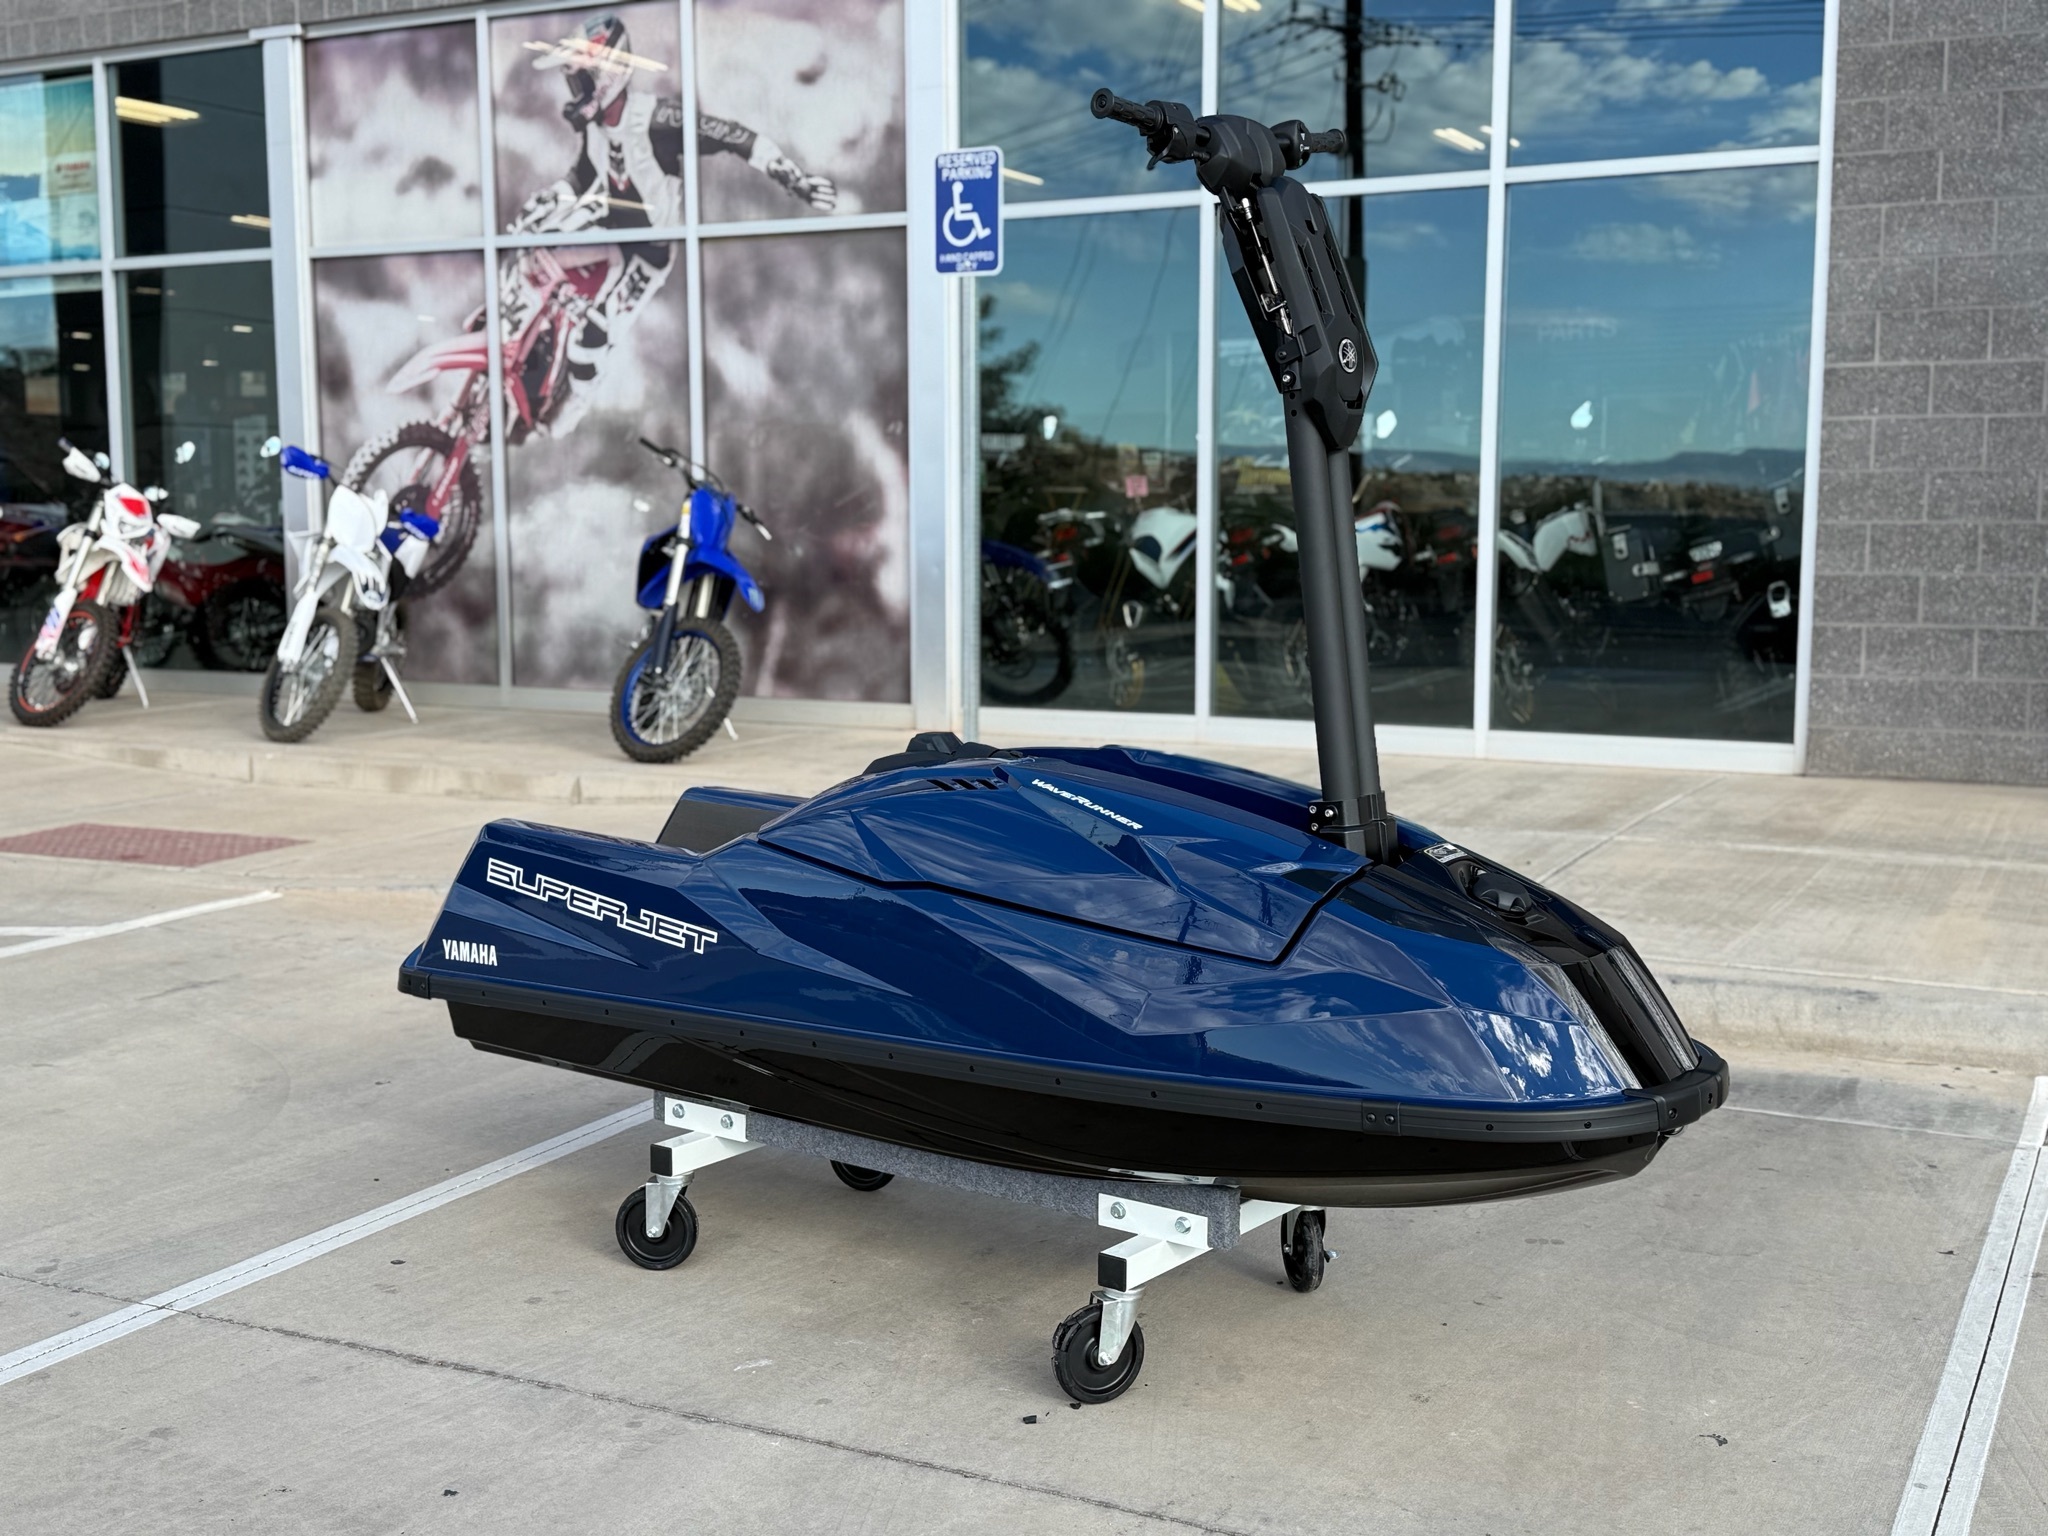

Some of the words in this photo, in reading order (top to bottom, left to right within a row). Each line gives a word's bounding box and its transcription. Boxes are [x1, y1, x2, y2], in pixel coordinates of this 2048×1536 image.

[938, 151, 997, 168] RESERVED
[941, 165, 993, 182] PARKING
[486, 857, 718, 955] SUPERJET
[442, 938, 498, 967] YAMAHA
